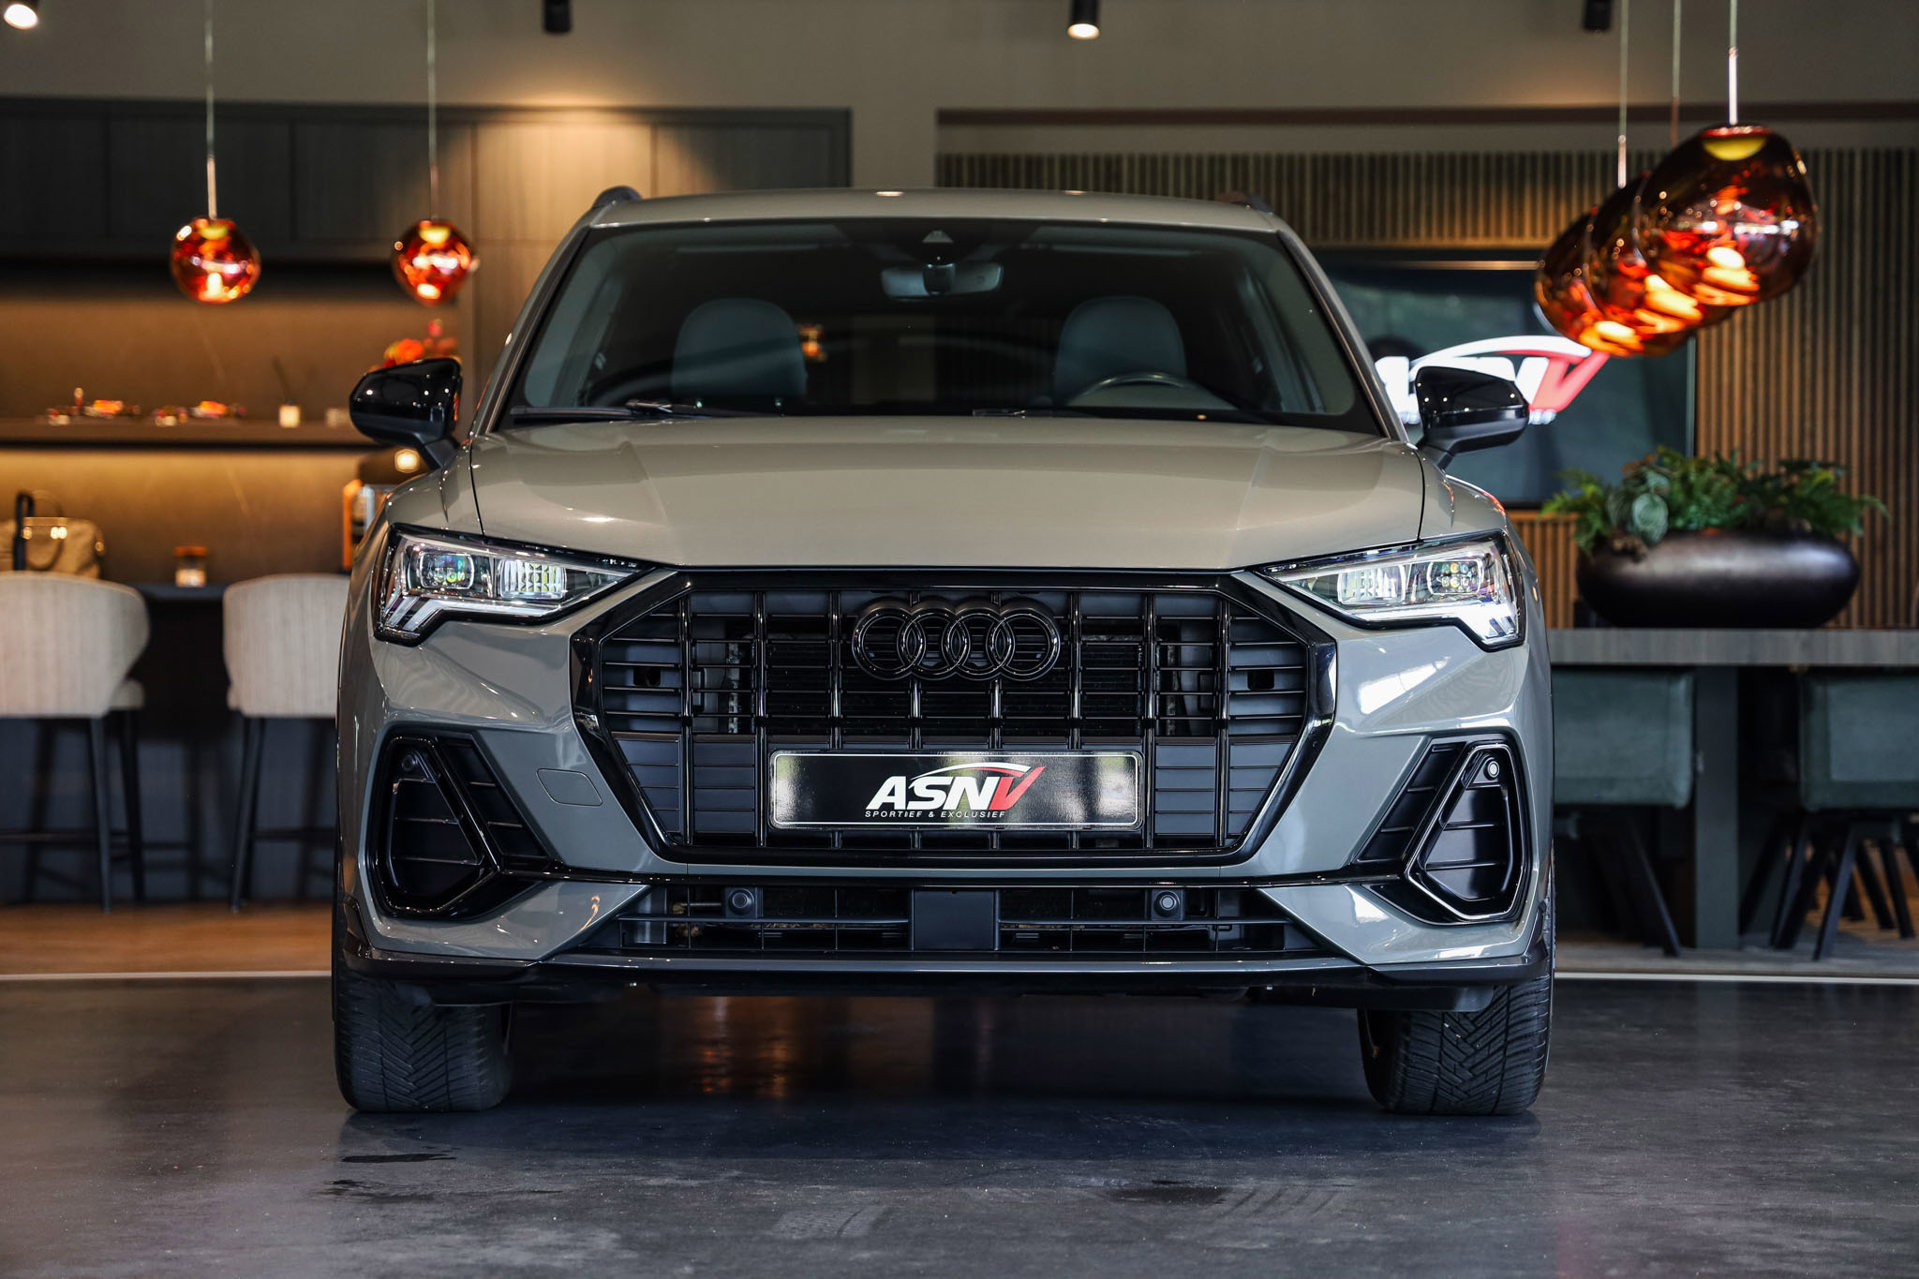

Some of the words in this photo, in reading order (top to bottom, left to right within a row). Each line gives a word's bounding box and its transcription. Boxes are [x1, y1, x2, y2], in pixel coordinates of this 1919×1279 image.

[864, 810, 923, 818] SPORTIEF
[928, 810, 936, 818] &
[940, 810, 1006, 818] EXCLUSIEF
